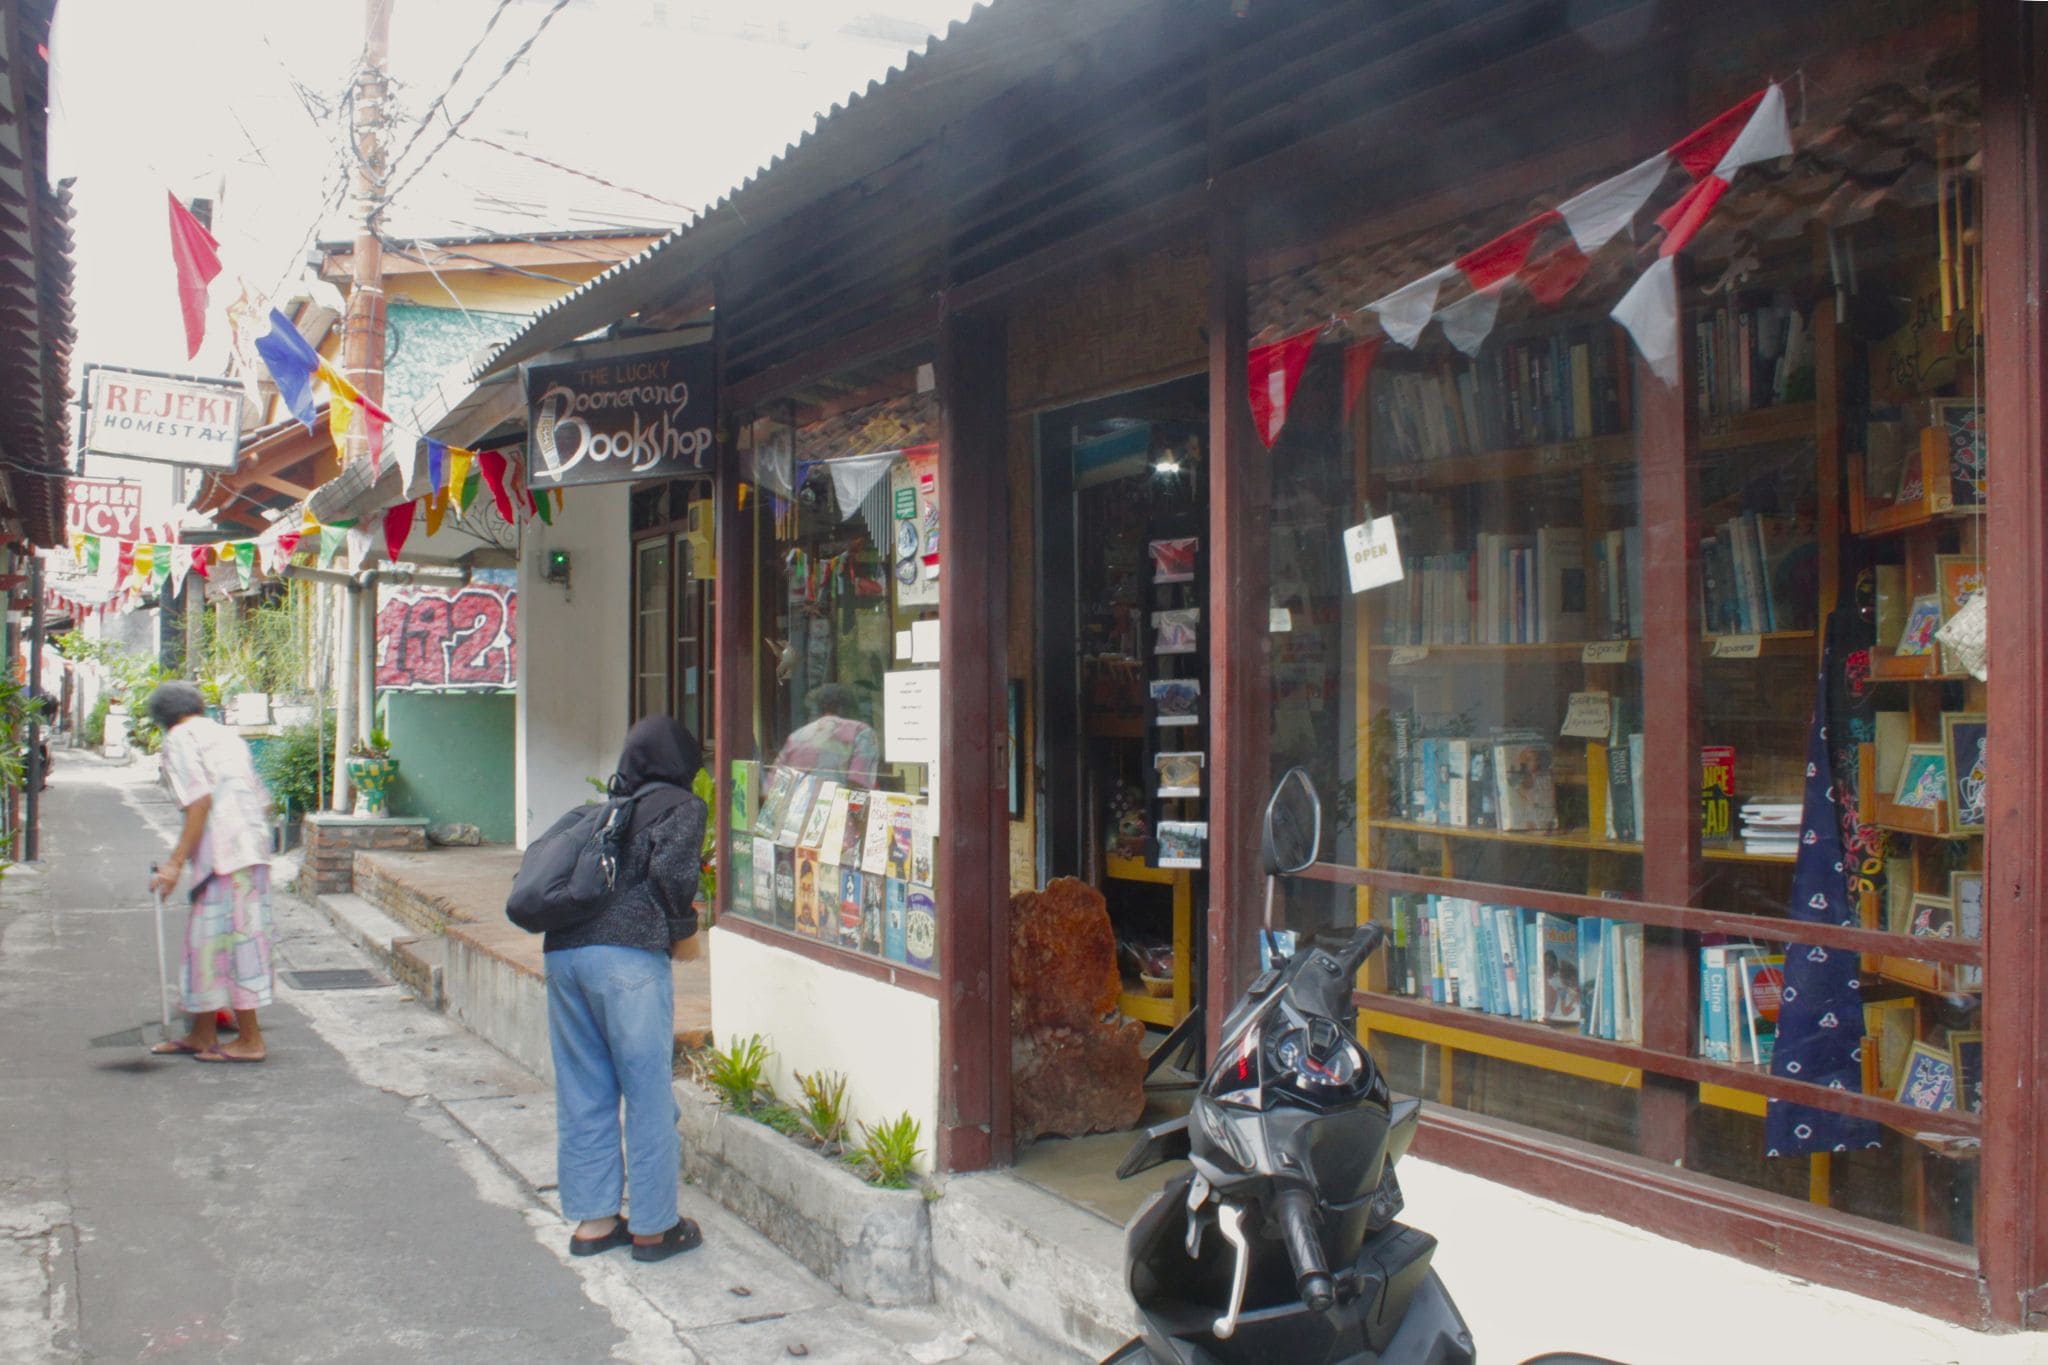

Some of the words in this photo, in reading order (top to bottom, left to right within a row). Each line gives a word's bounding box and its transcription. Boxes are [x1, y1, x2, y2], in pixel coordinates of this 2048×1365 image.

[577, 366, 610, 385] THE
[616, 360, 671, 383] LUCKY
[106, 384, 233, 426] REJEKI
[538, 382, 690, 424] Boomerang
[104, 415, 228, 442] HOMESTAY
[534, 410, 712, 477] Bookshop
[69, 484, 139, 506] SMEN
[1355, 542, 1388, 564] OPEN
[1711, 974, 1723, 1013] China
